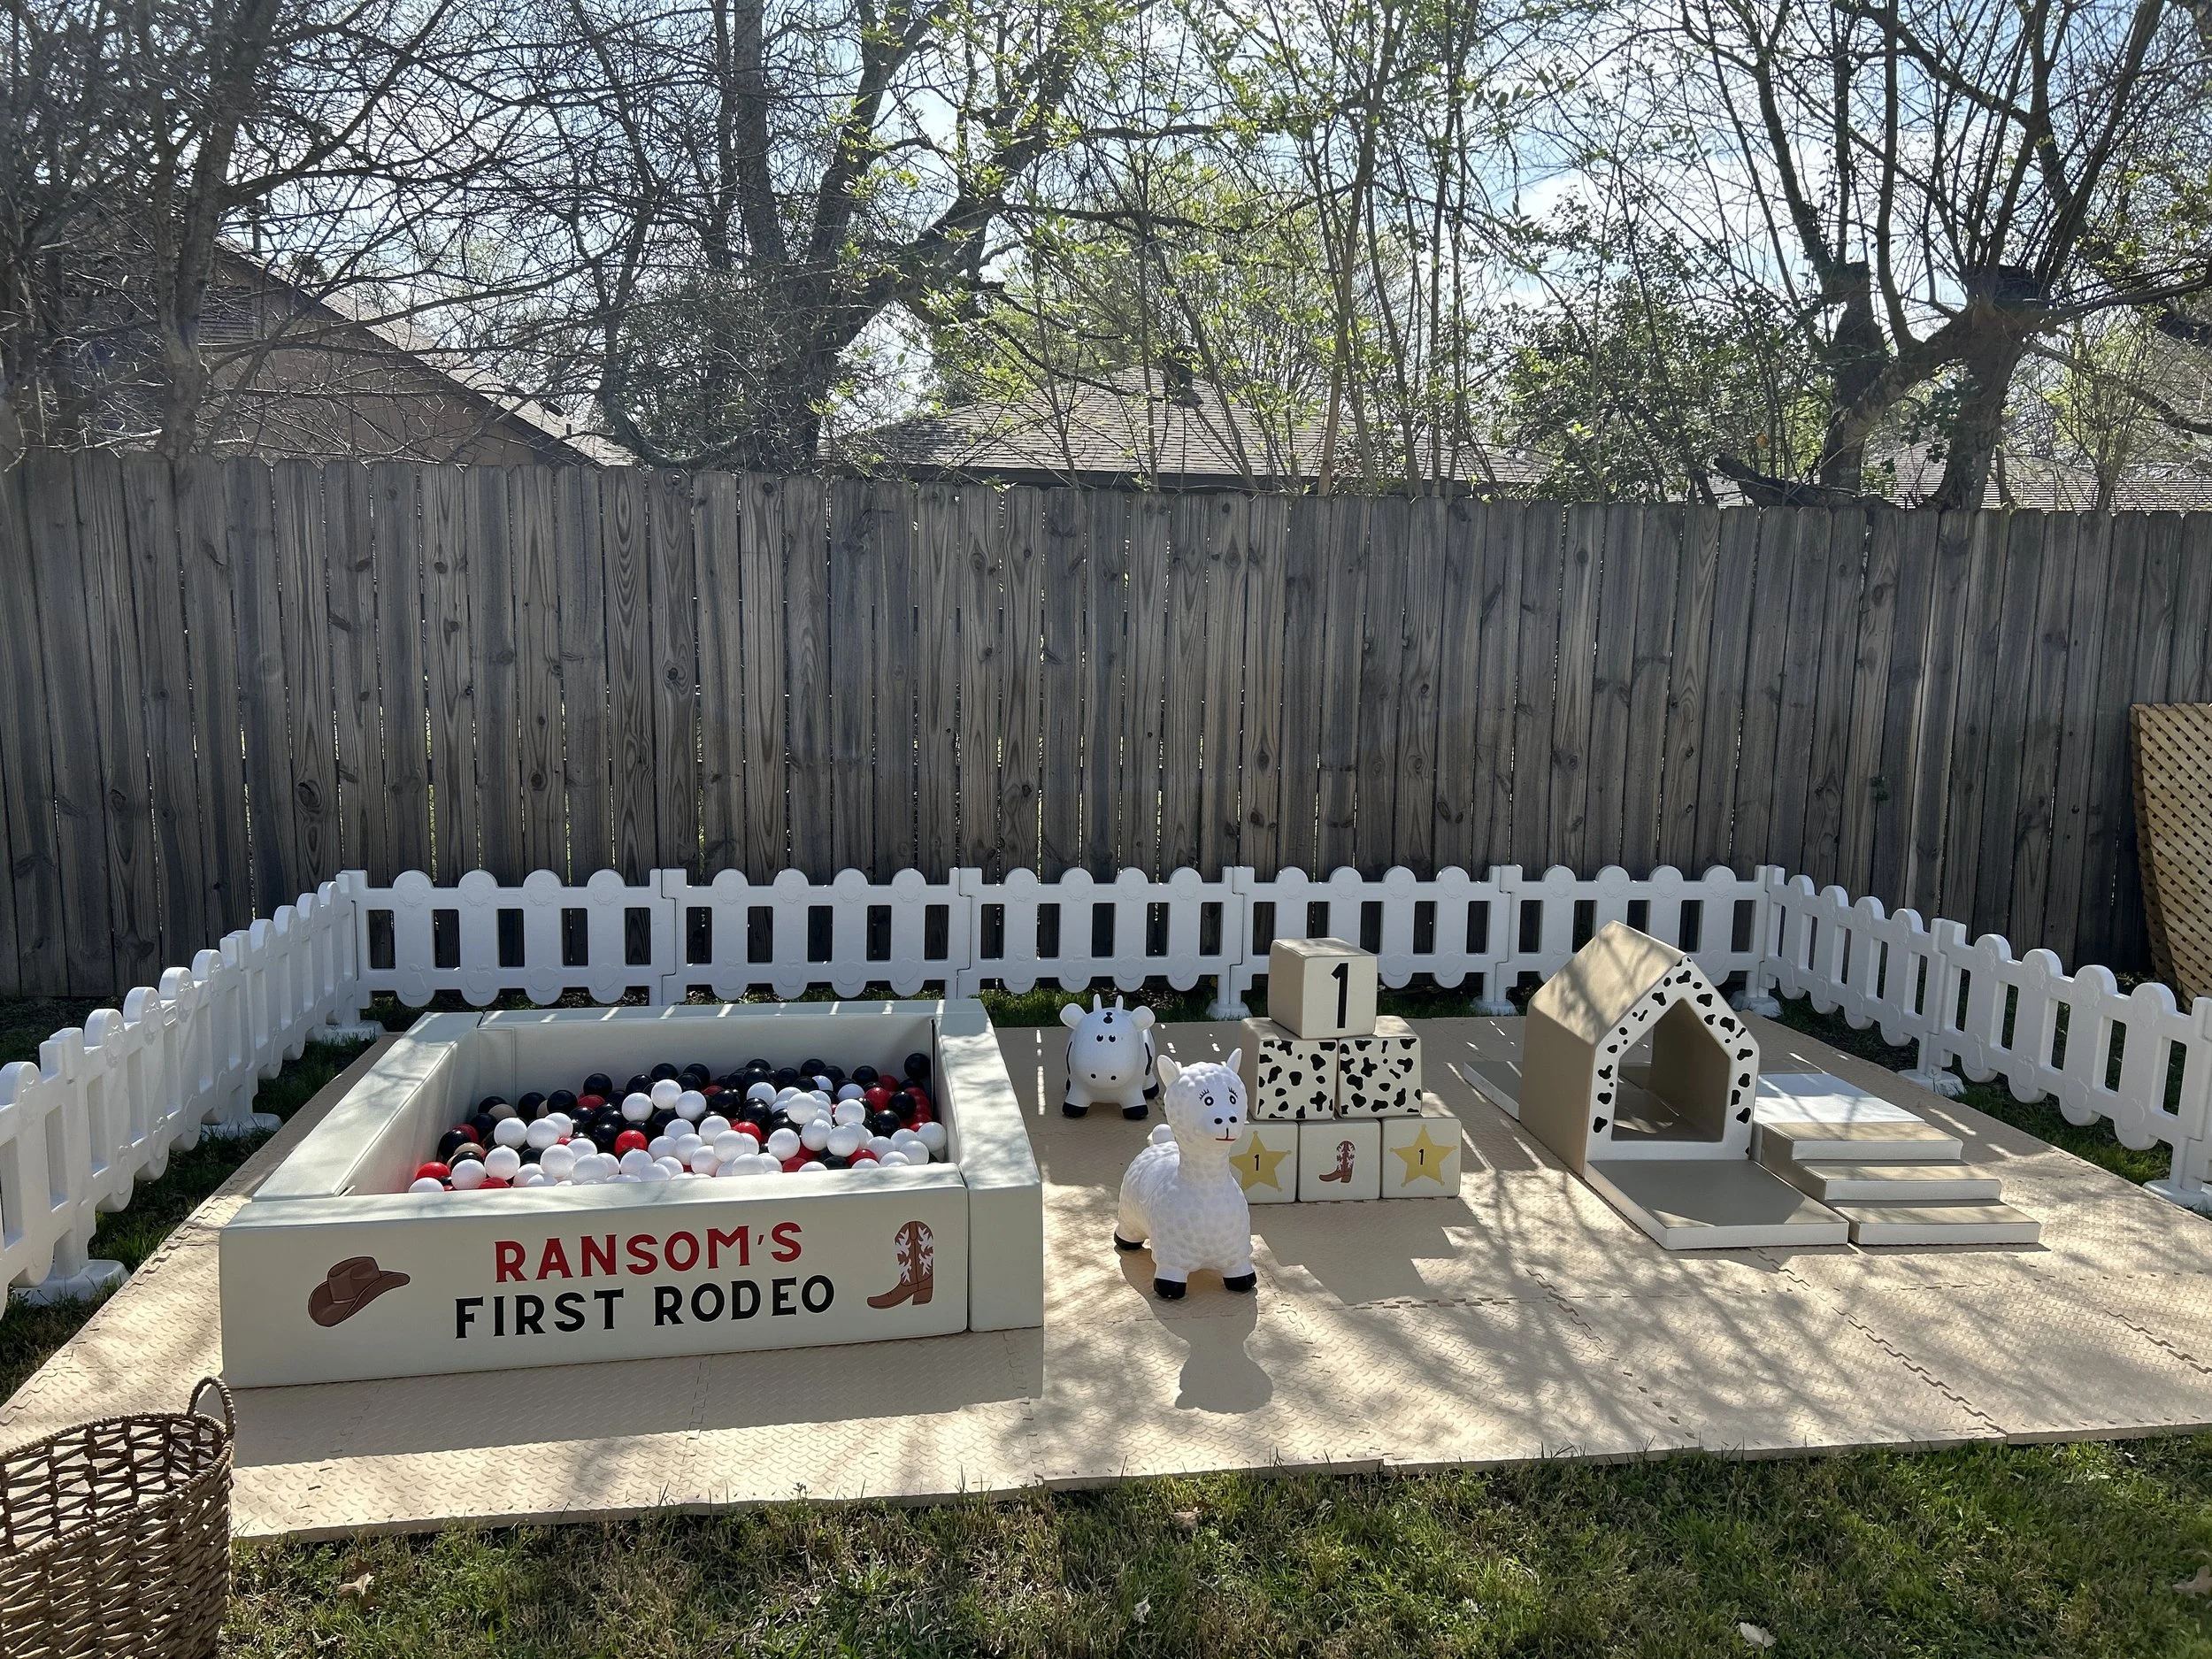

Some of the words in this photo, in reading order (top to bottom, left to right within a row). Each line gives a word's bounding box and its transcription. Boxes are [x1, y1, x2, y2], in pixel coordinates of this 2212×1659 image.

[1331, 962, 1349, 1029] 1
[1254, 1154, 1260, 1171] 1
[1418, 1148, 1425, 1165] 1
[495, 1221, 803, 1283] RANSOM'S
[454, 1287, 624, 1340] FIRST
[653, 1273, 836, 1327] RODEO
